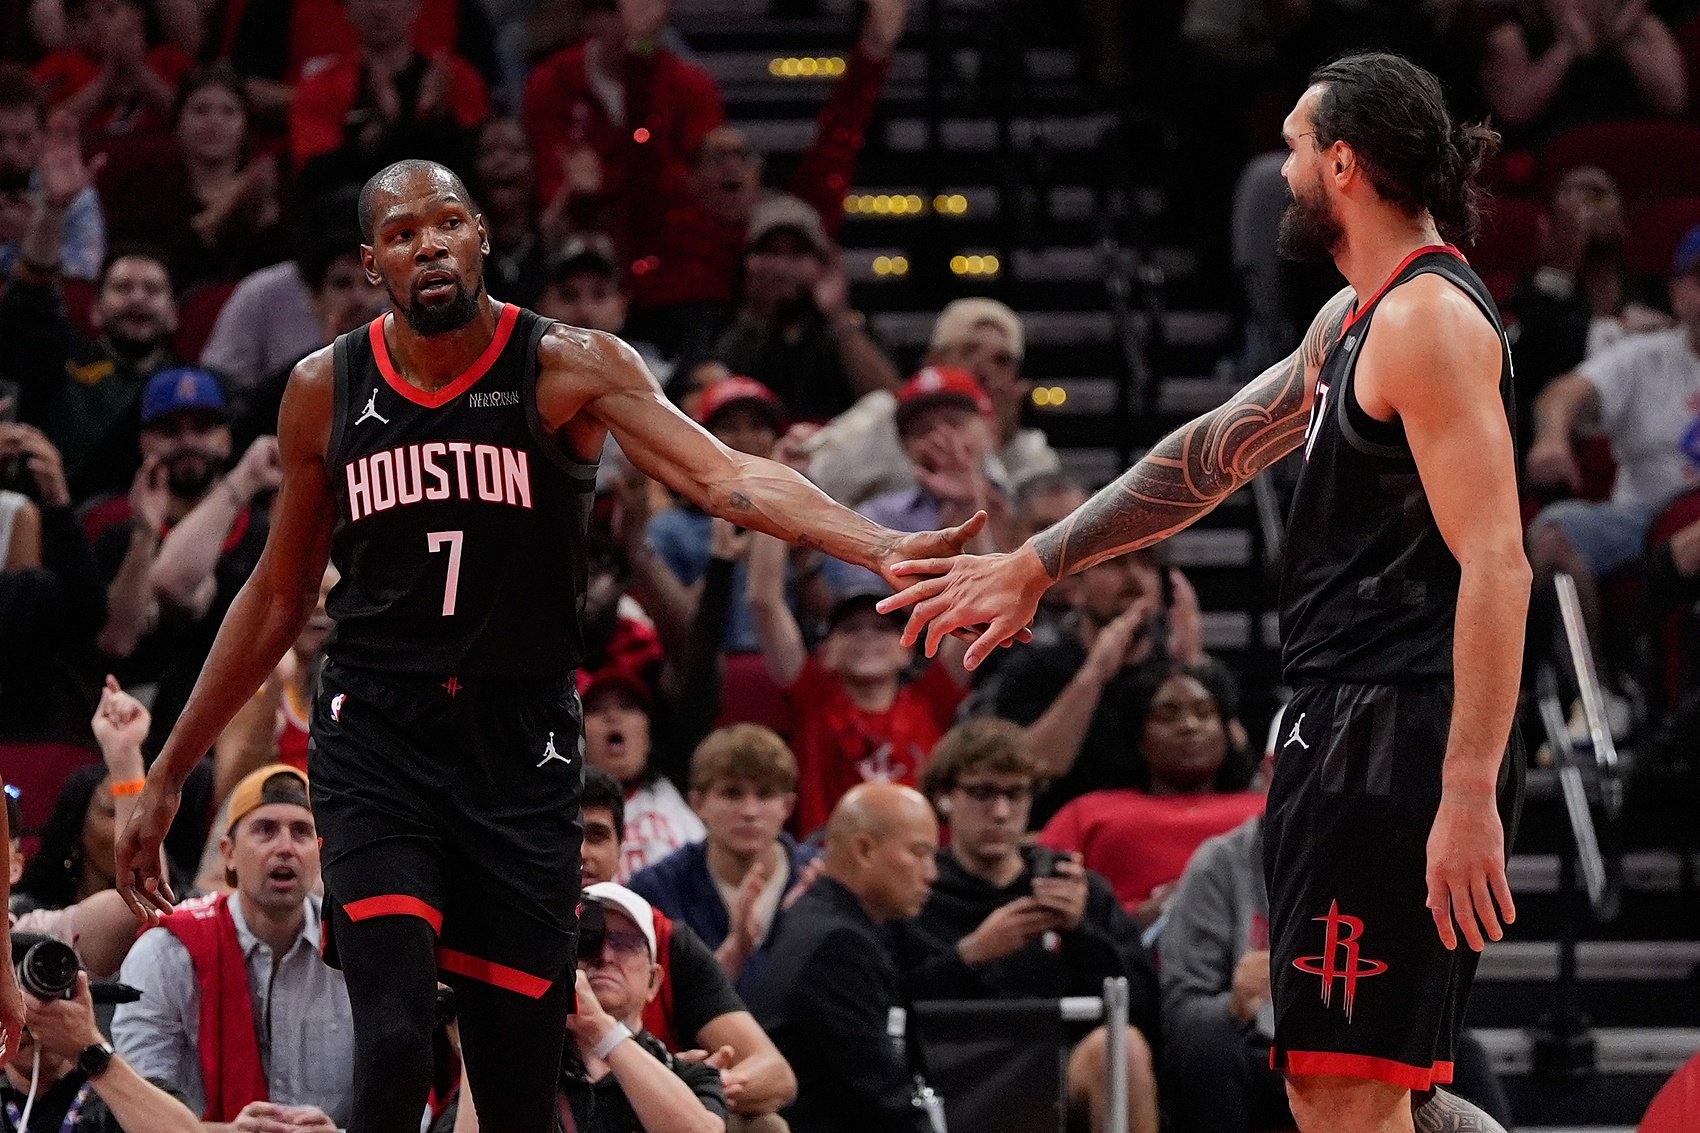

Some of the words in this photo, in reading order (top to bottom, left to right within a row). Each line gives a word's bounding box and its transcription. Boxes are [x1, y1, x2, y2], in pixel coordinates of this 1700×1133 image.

[469, 390, 519, 401] MEMORIAL
[469, 398, 519, 407] HERMANN
[345, 441, 533, 522] HOUSTON
[427, 530, 464, 616] 7
